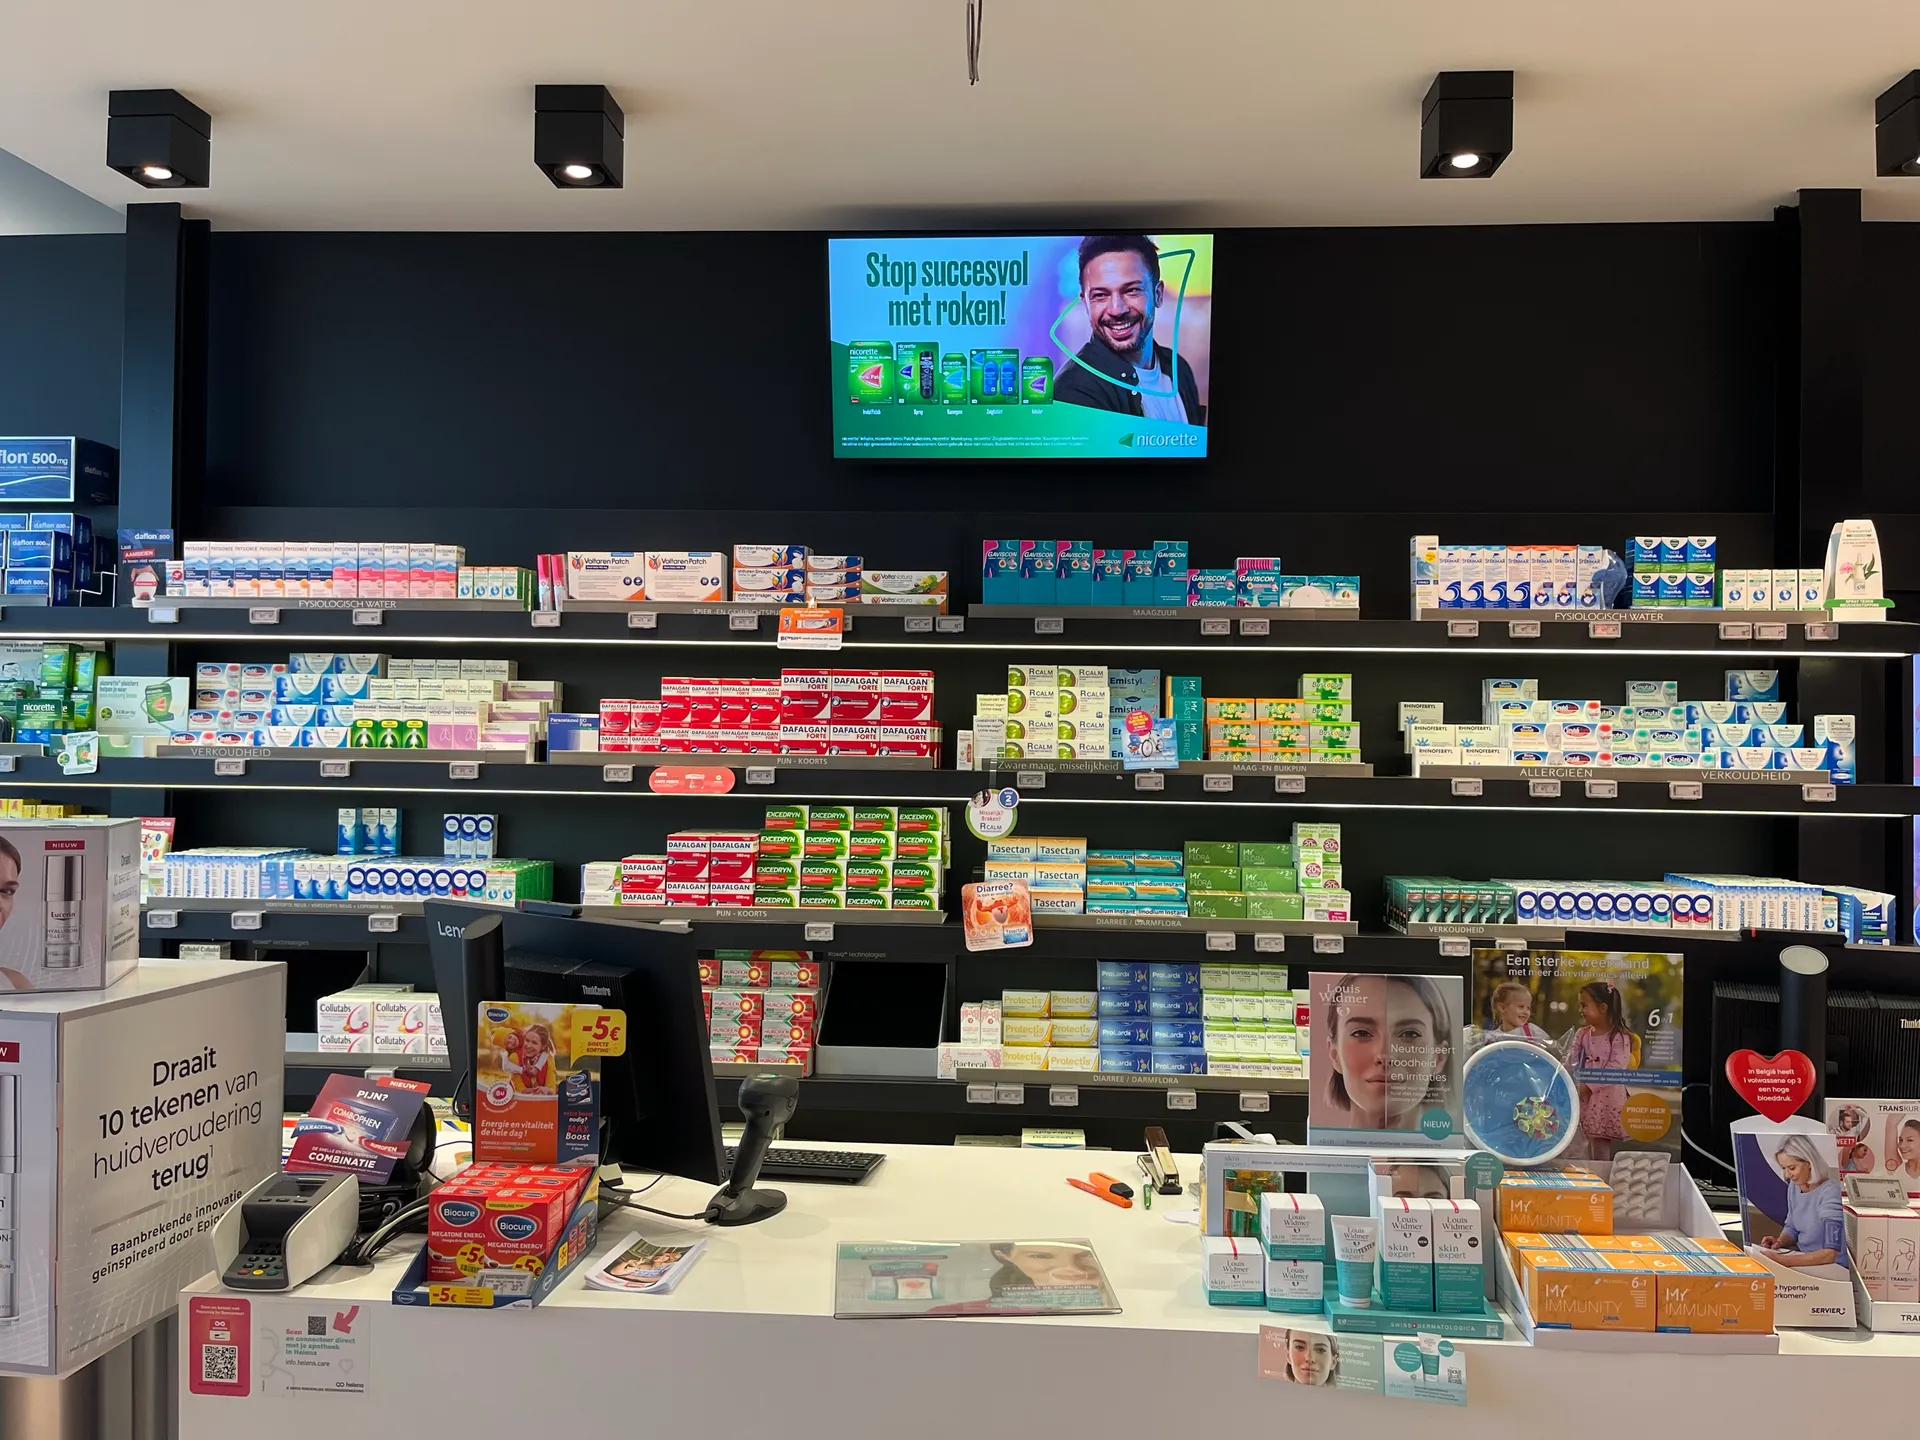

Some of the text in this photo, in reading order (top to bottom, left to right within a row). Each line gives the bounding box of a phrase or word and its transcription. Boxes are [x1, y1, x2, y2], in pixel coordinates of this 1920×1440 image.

[866, 250, 1029, 295] Stop succesvol
[889, 290, 1007, 326] met roken!
[1137, 432, 1198, 448] nicorette
[124, 550, 154, 558] AAMBEIEN
[987, 551, 1018, 559] GAVISCON
[584, 557, 630, 566] Voltaren Patch
[661, 557, 707, 566] Voltaren Patch
[9, 578, 32, 586] daflon
[1191, 574, 1227, 583] GAVISCON
[1239, 575, 1276, 583] GAVISCON
[299, 600, 397, 609] FYSIOLOGISCH WATER
[692, 608, 712, 616] SPIER
[1133, 608, 1178, 617] MAAGZUUR
[1554, 612, 1665, 621] FYSIOLOGISCH WATER
[783, 676, 829, 684] DAFALGAN
[834, 677, 880, 685] DAFALGAN
[1110, 677, 1144, 686] Emistyl
[1312, 681, 1344, 689] Buscopan
[822, 693, 829, 701] 1g
[23, 703, 55, 713] nicorette
[1183, 723, 1191, 756] GASTRIC
[190, 748, 271, 758] VERKOUDHEID
[777, 758, 829, 766] PIJN KOORTS
[1668, 756, 1693, 764] Sinutab
[998, 762, 1120, 773] Zware maag, misselijkheid
[1274, 765, 1308, 773] BUIKPIJN
[1701, 771, 1792, 781] VERKOUDHEID
[766, 811, 801, 819] EXCEDRYN
[979, 809, 1004, 817] Misselijk?
[990, 845, 1030, 854] Tasectan
[976, 883, 1014, 894] Diarree?
[1034, 899, 1076, 908] Tasectan
[51, 911, 76, 919] Eucerin
[737, 910, 767, 918] KOORTS
[1096, 918, 1182, 927] DIARREE DARMFLORA
[1429, 926, 1485, 934] VERKOUDHEID
[1506, 954, 1650, 970] Een sterke weerstand
[1508, 967, 1647, 980] met meer dan vitamines alleen
[1327, 984, 1360, 993] Louis
[1004, 994, 1042, 1006] Protectis
[1053, 994, 1091, 1005] Protectis
[1319, 993, 1369, 1004] Widmer
[320, 1004, 352, 1014] Collutabs
[376, 1003, 408, 1013] Collutabs
[582, 1015, 622, 1042] -5€
[1390, 1044, 1456, 1054] Neutraliseert
[413, 1057, 444, 1065] KEELPIJN
[1390, 1058, 1437, 1068] roodheid
[152, 1046, 217, 1087] Draait
[1406, 1072, 1447, 1082] irritaties
[1756, 1068, 1776, 1077] België
[390, 1080, 418, 1090] NIEUW
[1093, 1076, 1179, 1085] DIARREE DARMFLORA
[1772, 1086, 1790, 1094] hoge
[356, 1090, 389, 1104] PIJN?
[99, 1070, 258, 1139] 10 tekenen van
[333, 1107, 382, 1130] COMBOPHEN
[569, 1117, 588, 1126] nodig?
[481, 1120, 509, 1130] Energie
[521, 1121, 554, 1130] vitaliteit
[481, 1128, 490, 1136] de
[492, 1128, 507, 1137] hele
[509, 1129, 524, 1139] dag
[565, 1133, 591, 1142] Boost
[94, 1099, 262, 1179] huidveroudering
[308, 1152, 377, 1169] COMBINATIE
[443, 1209, 476, 1217] Biocure
[110, 1189, 242, 1256] Baanbrekende innovatie
[1397, 1215, 1418, 1224] Louis
[1510, 1214, 1583, 1229] IMMUNITY
[500, 1223, 533, 1231] Biocure
[1391, 1222, 1424, 1231] Widmer
[488, 1241, 544, 1250] MEGATONE ENERGY
[1388, 1243, 1409, 1252] skin
[92, 1225, 194, 1284] geïnspireerd door
[1387, 1252, 1416, 1261] expert
[1779, 1284, 1820, 1293] hypertensie
[432, 1287, 457, 1304] -5€
[1545, 1301, 1623, 1315] IMMUNITY
[1811, 1307, 1841, 1315] SERVIER
[1390, 1321, 1476, 1332] SWISS DERMATOLOGICA
